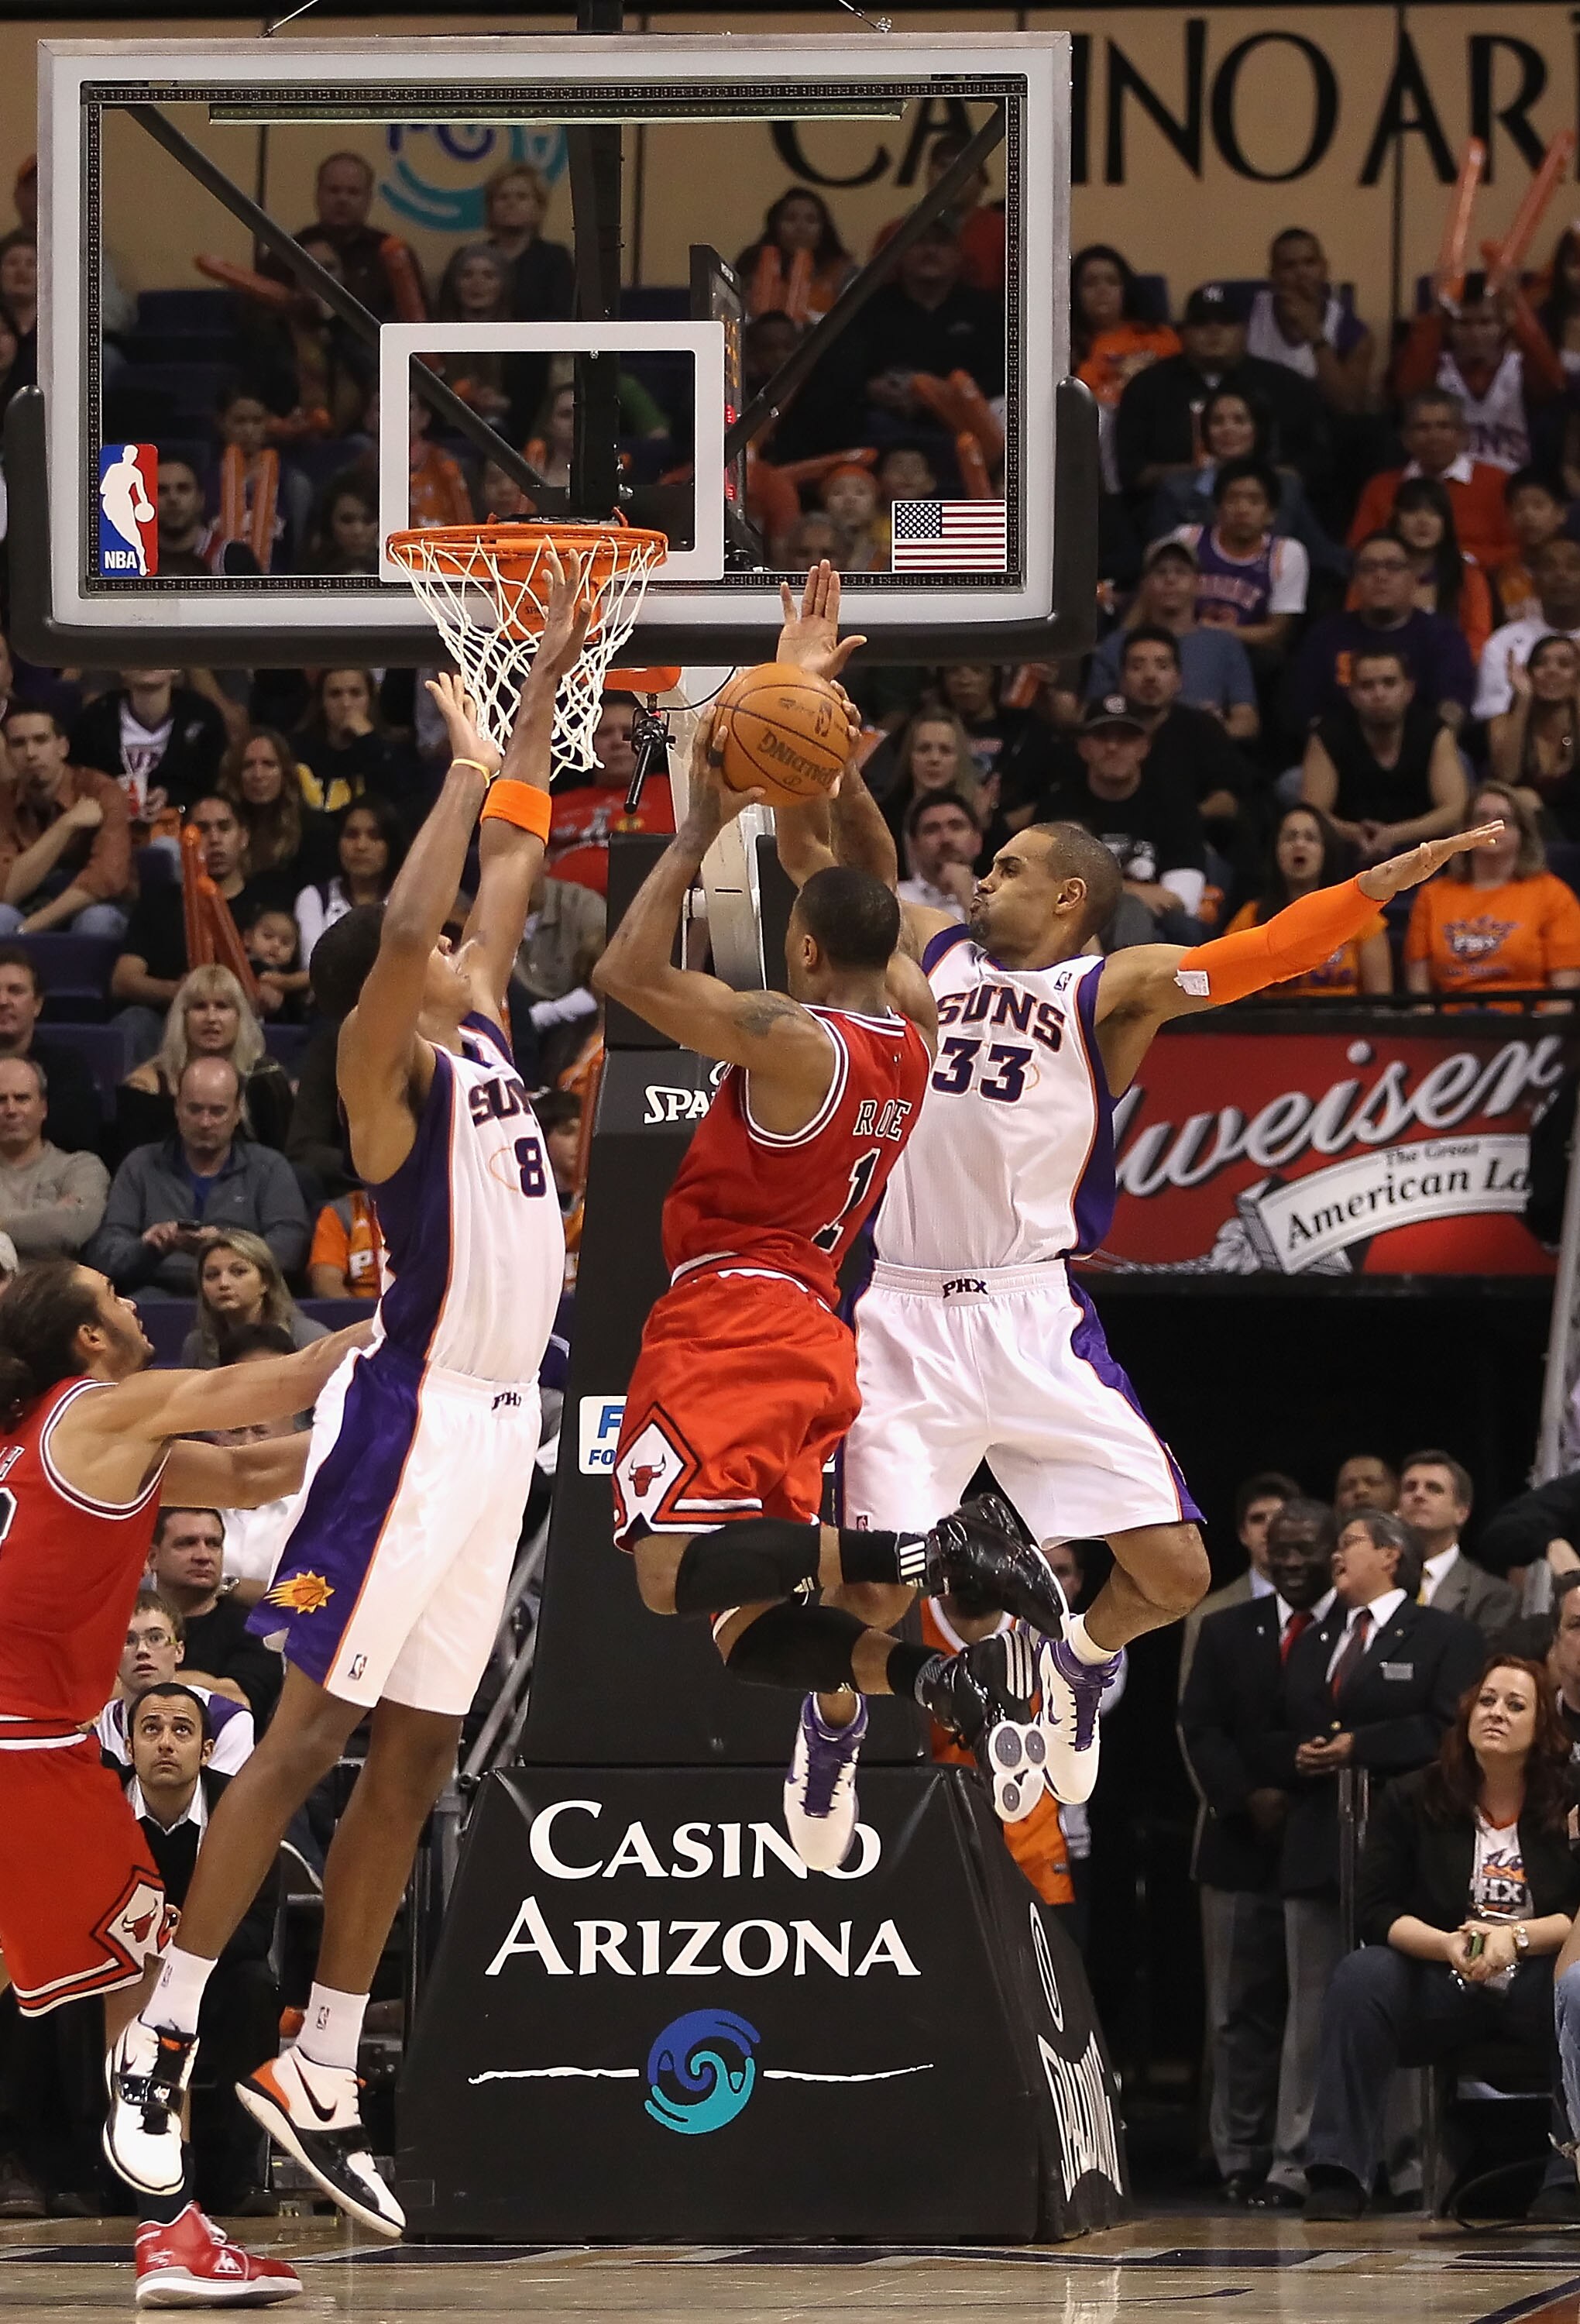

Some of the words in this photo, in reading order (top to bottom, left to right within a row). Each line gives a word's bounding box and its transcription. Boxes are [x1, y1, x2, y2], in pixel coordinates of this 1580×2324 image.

[1358, 11, 1580, 187] AR
[105, 551, 138, 569] NBA
[936, 984, 1066, 1053] SUNS
[930, 1036, 1036, 1104] 33
[644, 1085, 716, 1124] SPA
[513, 1136, 548, 1198] 8
[810, 1147, 881, 1254] 1
[1286, 1168, 1470, 1250] American
[942, 1277, 989, 1299] PHX
[484, 1895, 922, 1978] ARIZONA
